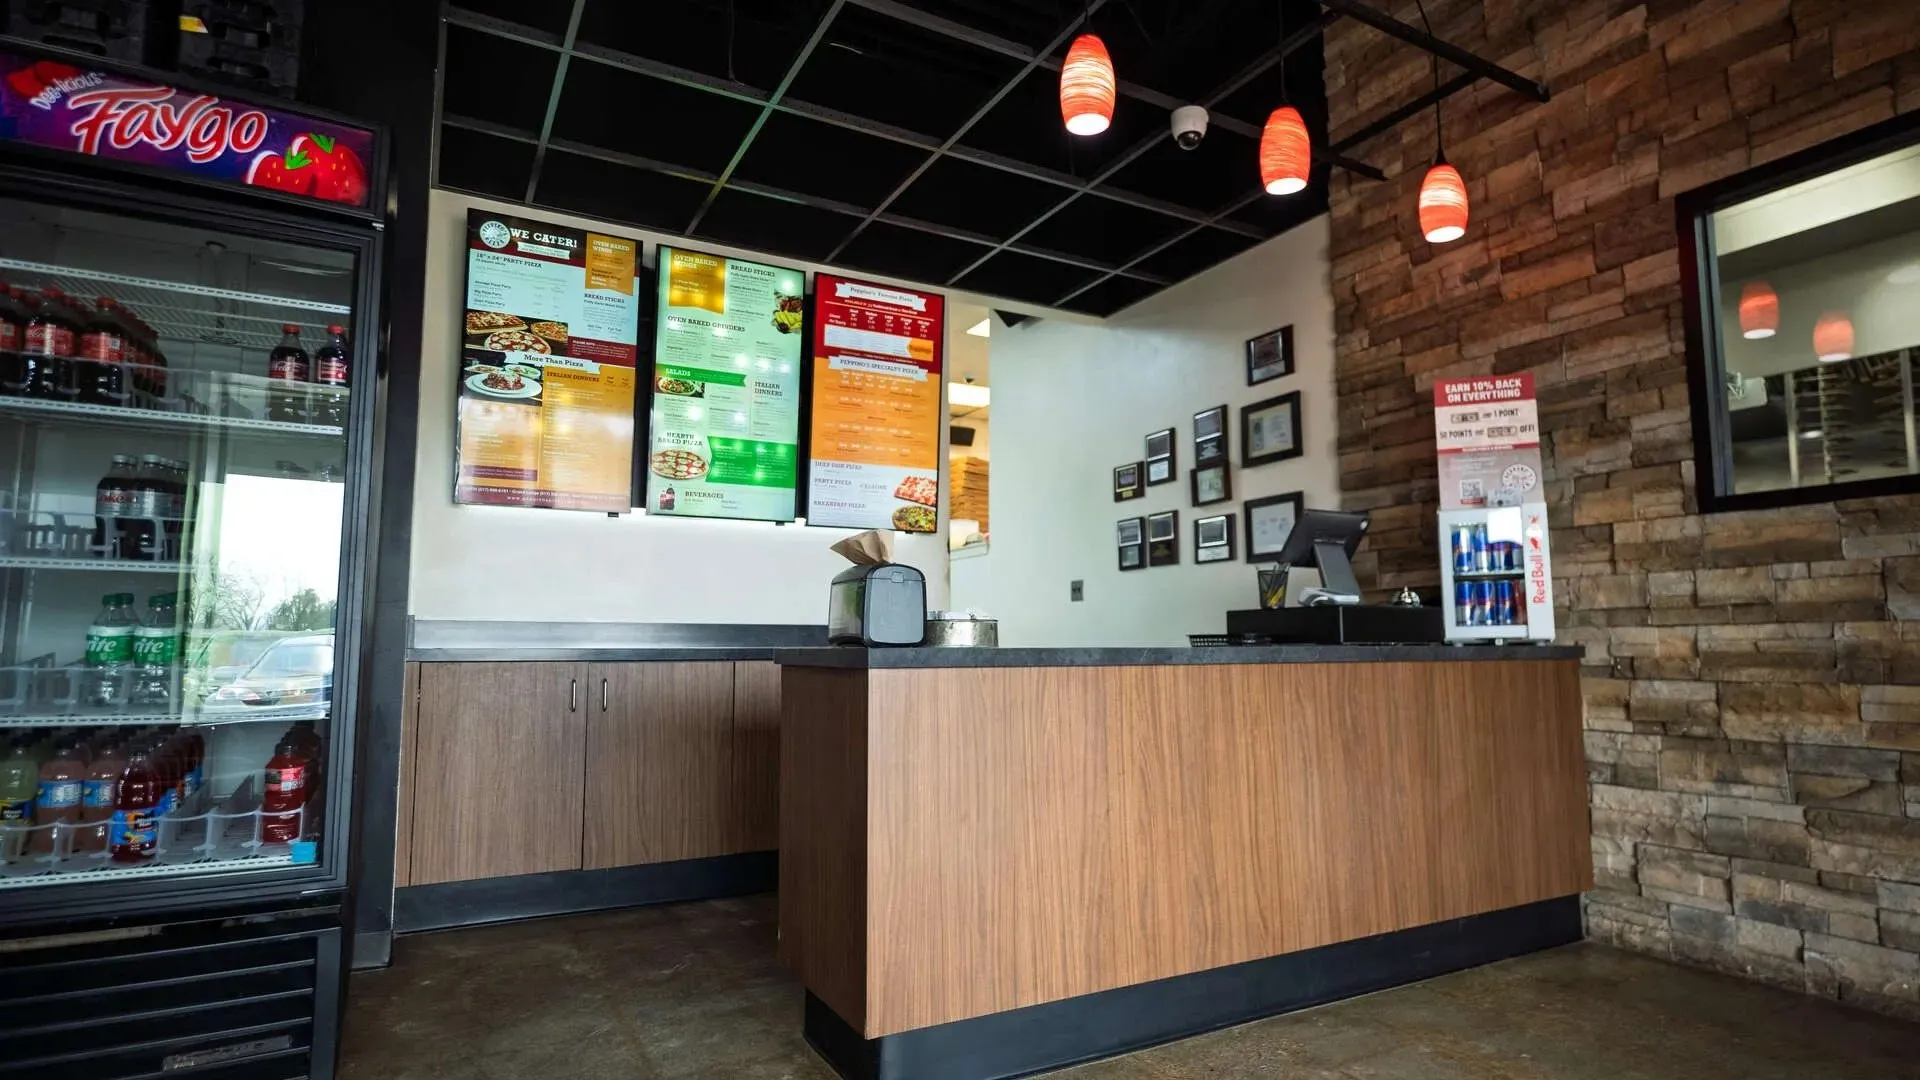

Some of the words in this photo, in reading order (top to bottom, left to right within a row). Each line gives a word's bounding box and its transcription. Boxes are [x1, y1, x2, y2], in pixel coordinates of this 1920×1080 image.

[68, 87, 270, 164] Faygo
[510, 227, 529, 240] WE
[533, 232, 578, 248] CATER!
[503, 258, 523, 266] PARTY
[731, 265, 753, 273] BREAD
[667, 315, 687, 324] OVEN
[688, 318, 711, 327] BAKED
[524, 353, 544, 363] More
[546, 357, 564, 365] Than
[565, 359, 584, 368] Pizza
[665, 367, 691, 377] SALADS
[754, 381, 780, 390] ITALIAN
[754, 388, 783, 397] DINNERS
[1445, 382, 1470, 394] EARN
[1472, 380, 1494, 391] 10%
[1495, 377, 1522, 389] BACK
[1447, 393, 1461, 403] ON
[1462, 388, 1521, 402] EVERYTHING
[1449, 429, 1473, 439] POINTS
[685, 490, 724, 499] BEVERAGES
[1530, 554, 1544, 578] Bull
[1532, 580, 1545, 604] Red
[87, 636, 118, 652] rite
[134, 638, 165, 654] rite
